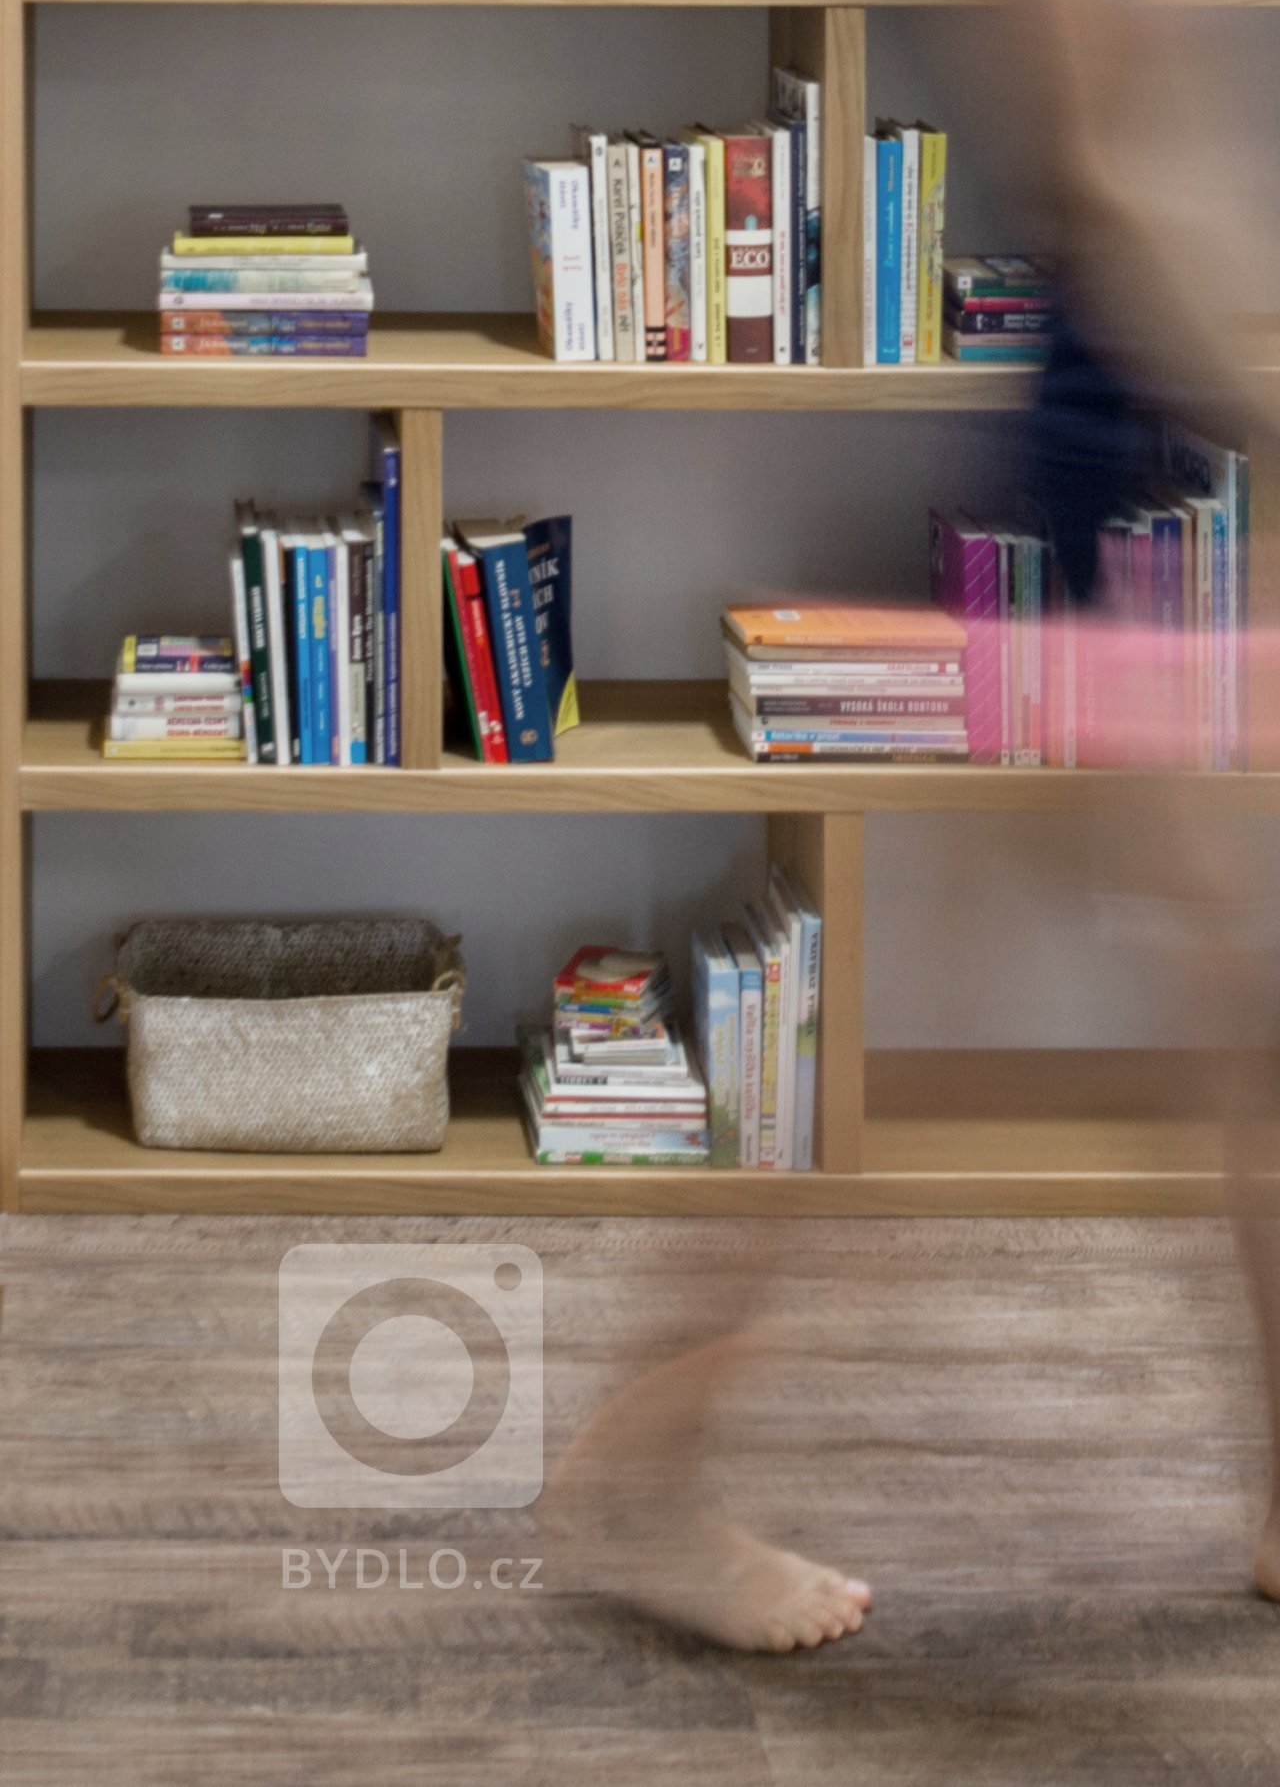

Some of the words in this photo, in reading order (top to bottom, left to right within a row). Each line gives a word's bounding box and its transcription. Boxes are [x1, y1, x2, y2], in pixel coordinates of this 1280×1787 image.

[730, 250, 769, 268] ECO
[491, 559, 511, 610] SLOVNÍK
[498, 611, 523, 685] AKADEMICKÝ
[510, 688, 528, 720] NOVÝ
[840, 698, 872, 711] VYSOKÁ
[876, 697, 904, 711] ŠKOLA
[908, 700, 949, 712] BONTONU
